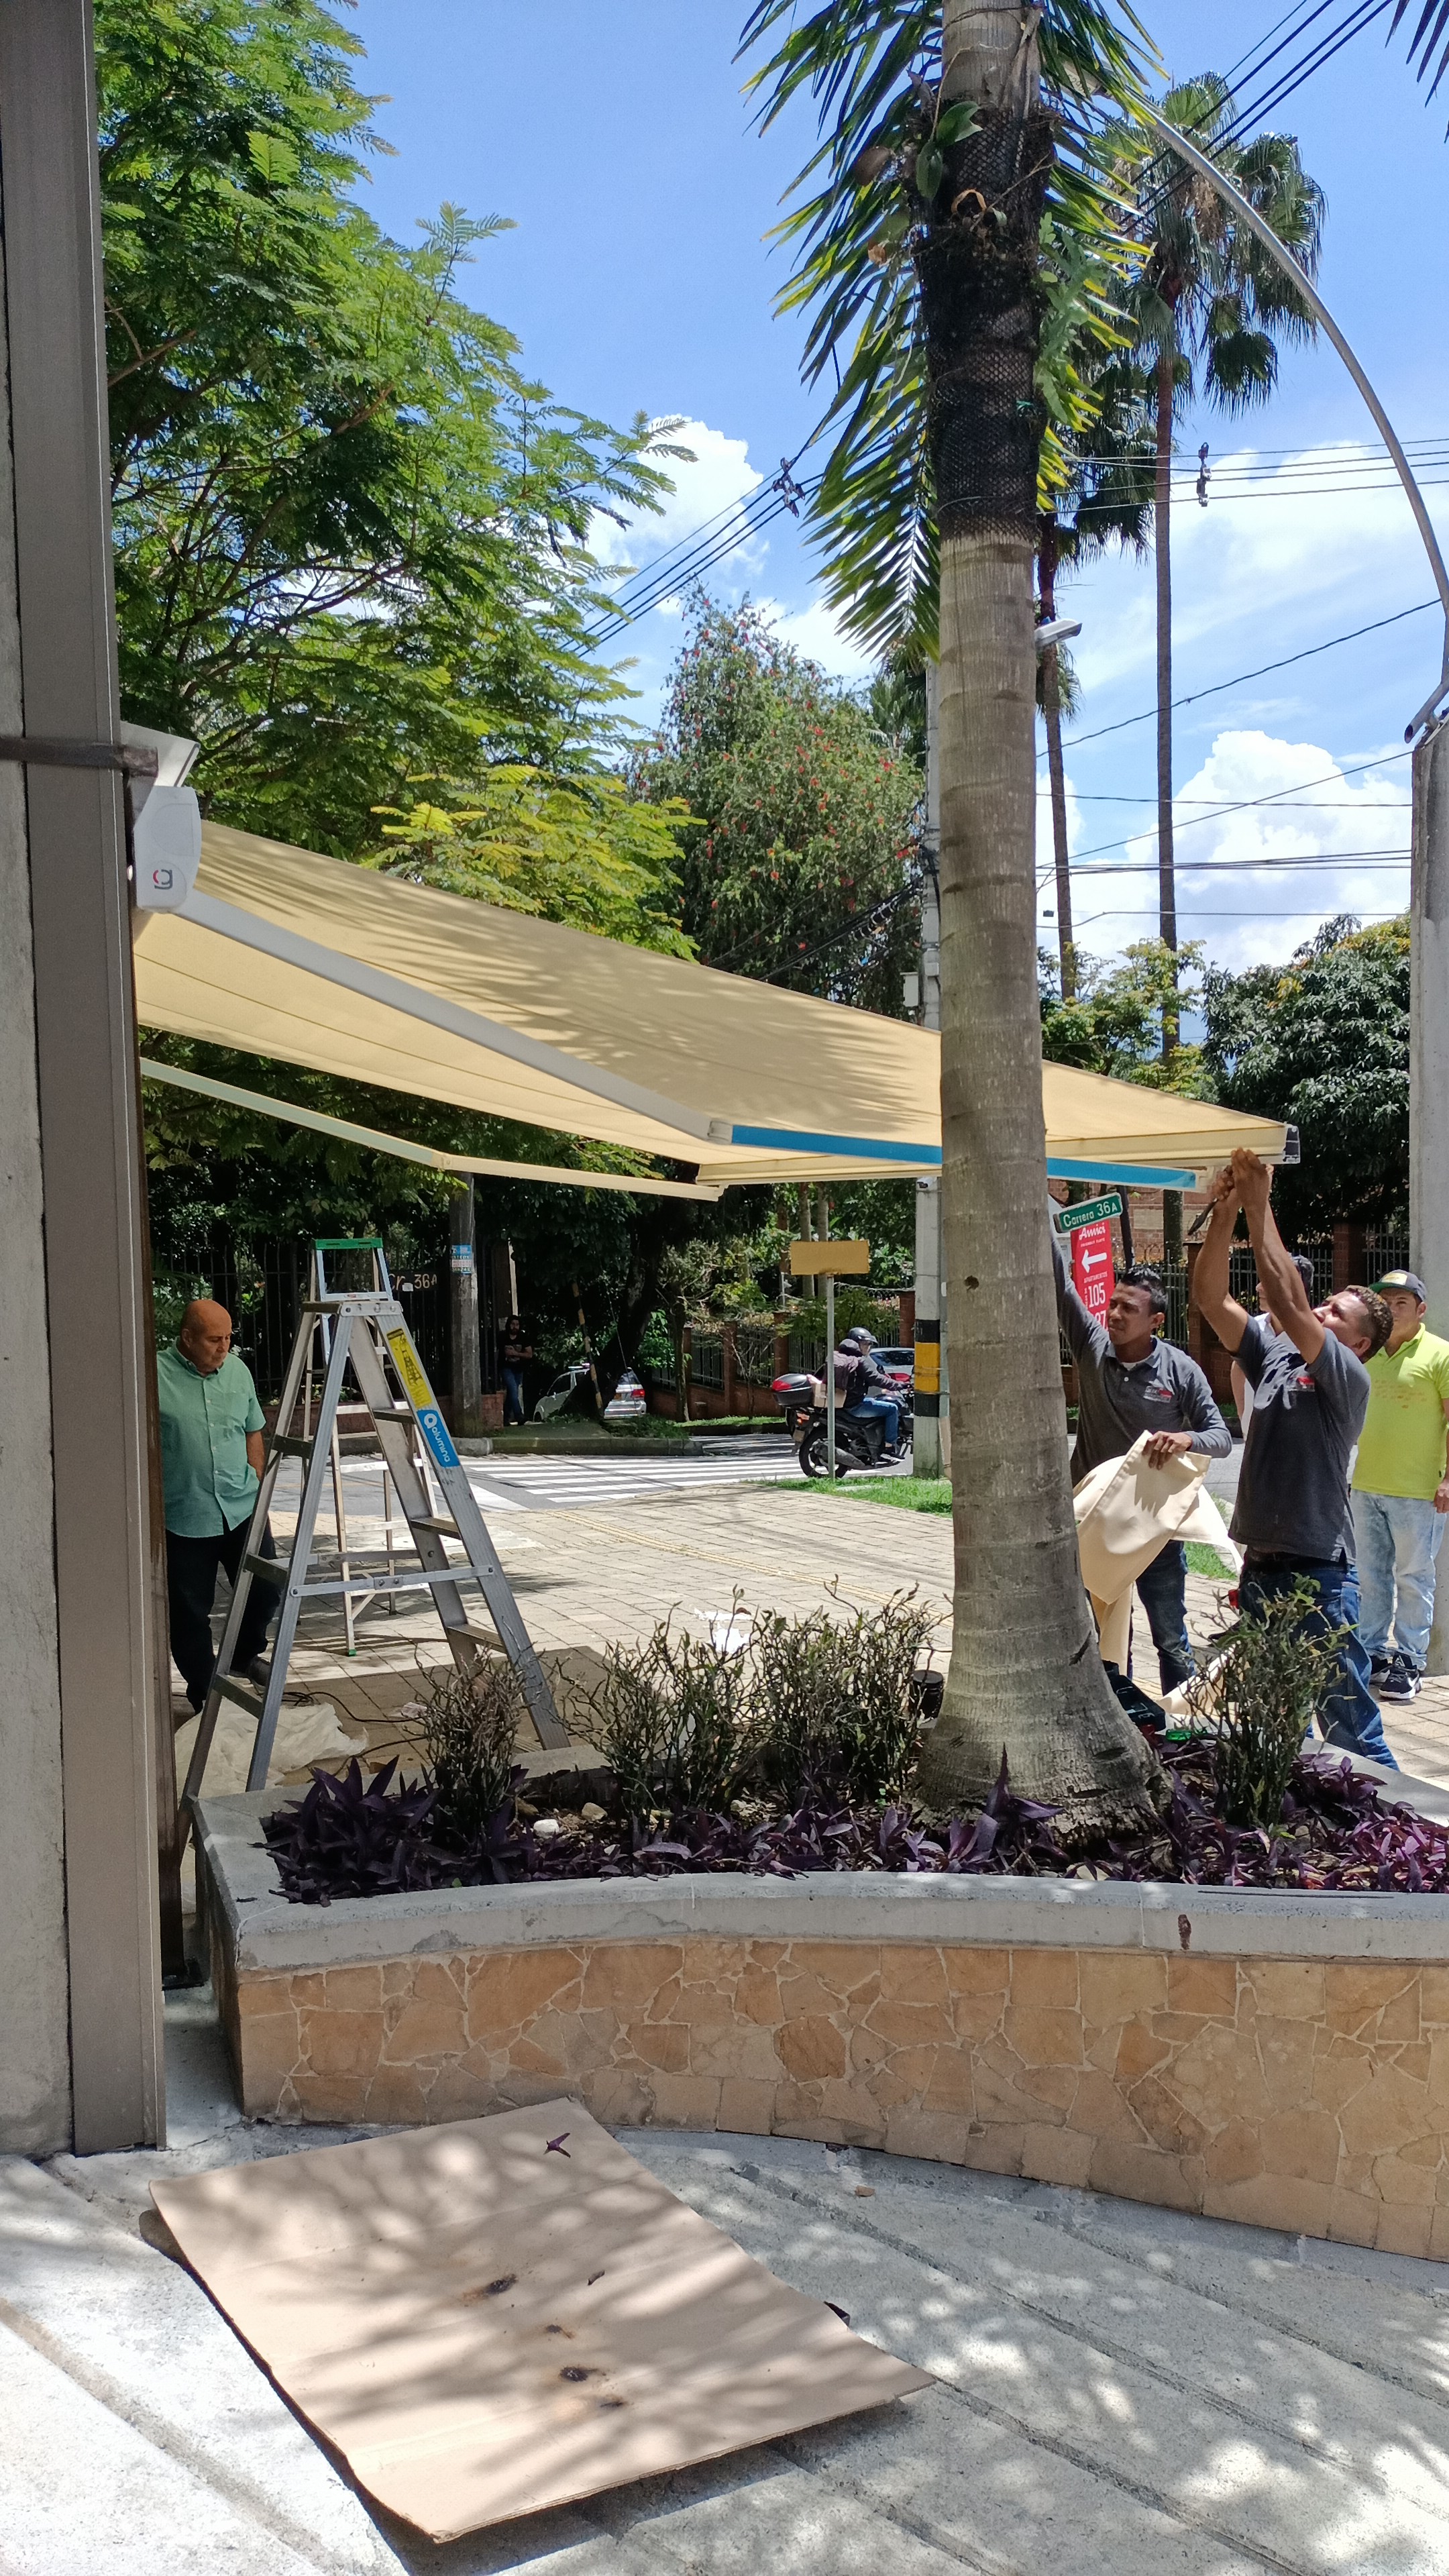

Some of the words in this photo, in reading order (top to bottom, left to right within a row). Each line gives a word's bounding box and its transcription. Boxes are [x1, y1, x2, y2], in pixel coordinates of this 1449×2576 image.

[1063, 1211, 1095, 1227] Carrera
[1096, 1201, 1118, 1216] 36A
[1079, 1222, 1106, 1241] Amici
[414, 1273, 437, 1289] 36A
[1088, 1282, 1106, 1308] 105
[431, 1426, 451, 1463] alumina
